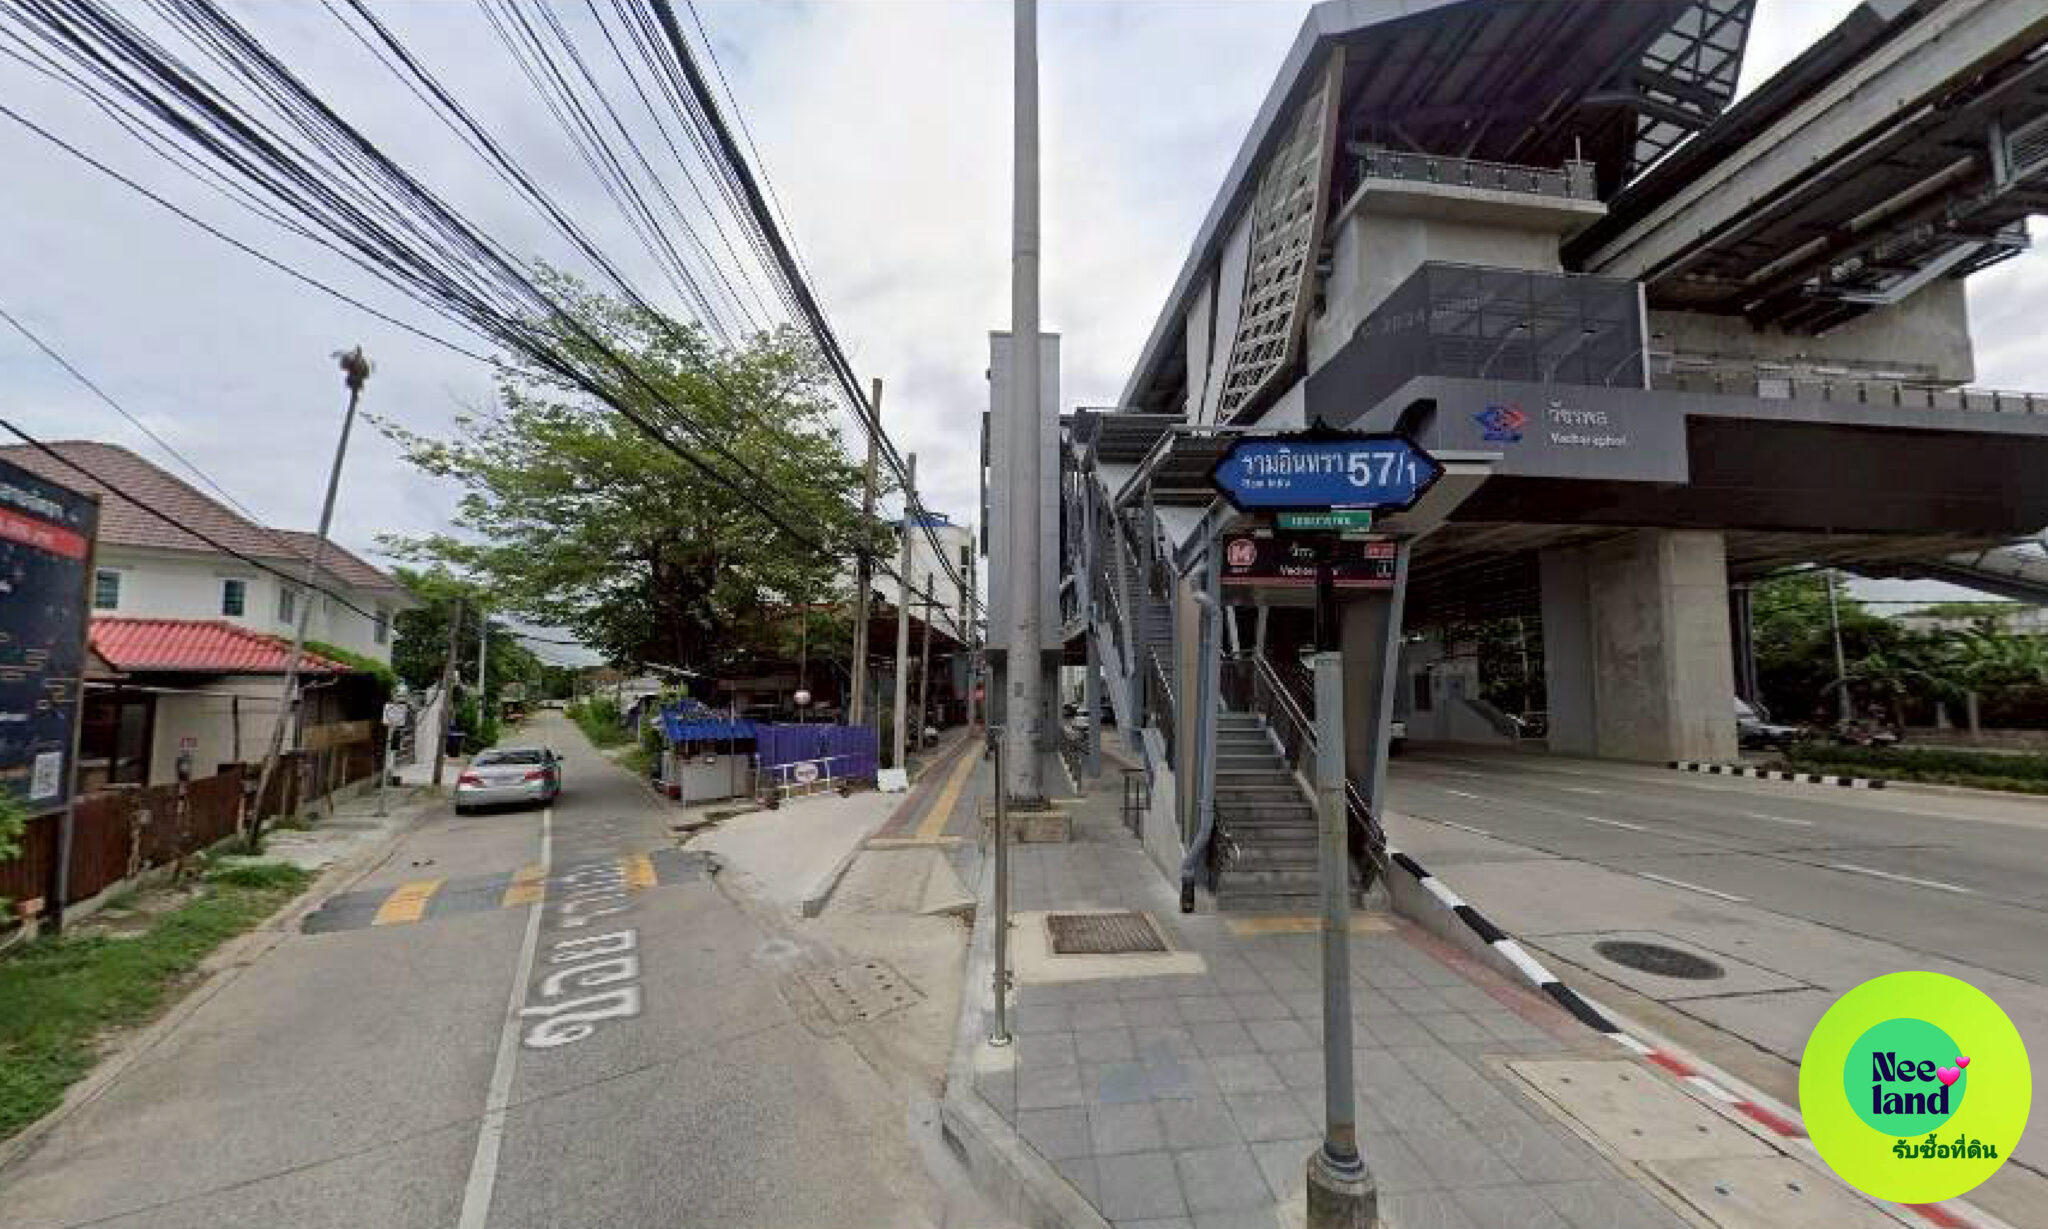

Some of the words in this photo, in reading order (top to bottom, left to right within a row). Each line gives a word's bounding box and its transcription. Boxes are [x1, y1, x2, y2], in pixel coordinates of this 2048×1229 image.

[1241, 447, 1344, 475] รามอินทรา
[1347, 450, 1417, 490] 57/1
[518, 929, 641, 1047] ซอย
